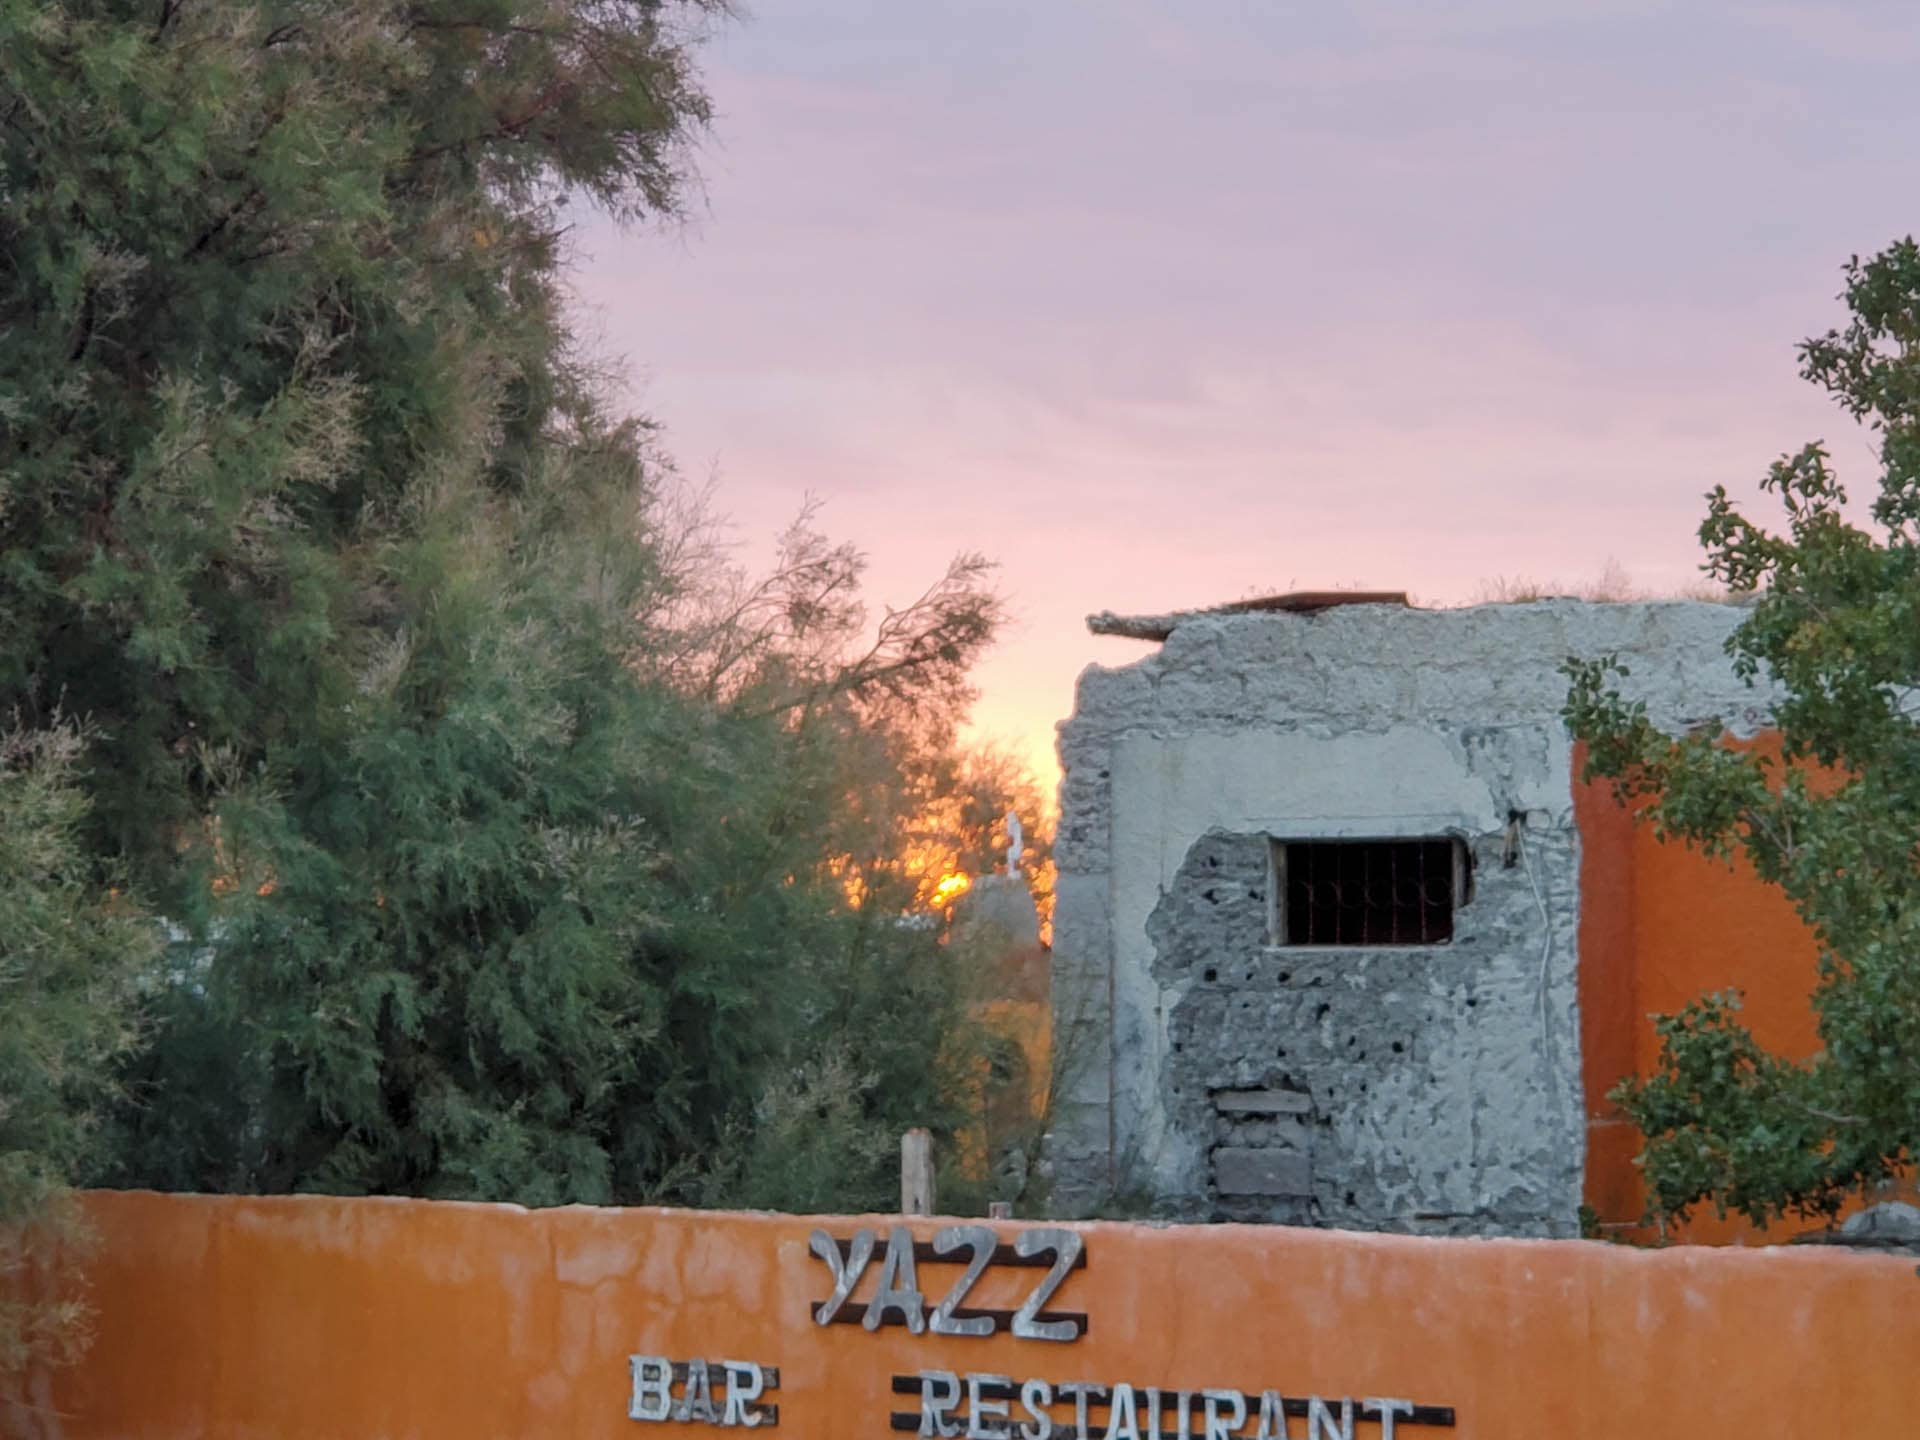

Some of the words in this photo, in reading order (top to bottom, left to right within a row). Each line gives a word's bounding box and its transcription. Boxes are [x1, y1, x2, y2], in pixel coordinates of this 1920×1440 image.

[808, 1224, 1084, 1341] YAZZ
[628, 1355, 764, 1427] BAR
[918, 1369, 1414, 1440] RESTAURANT
